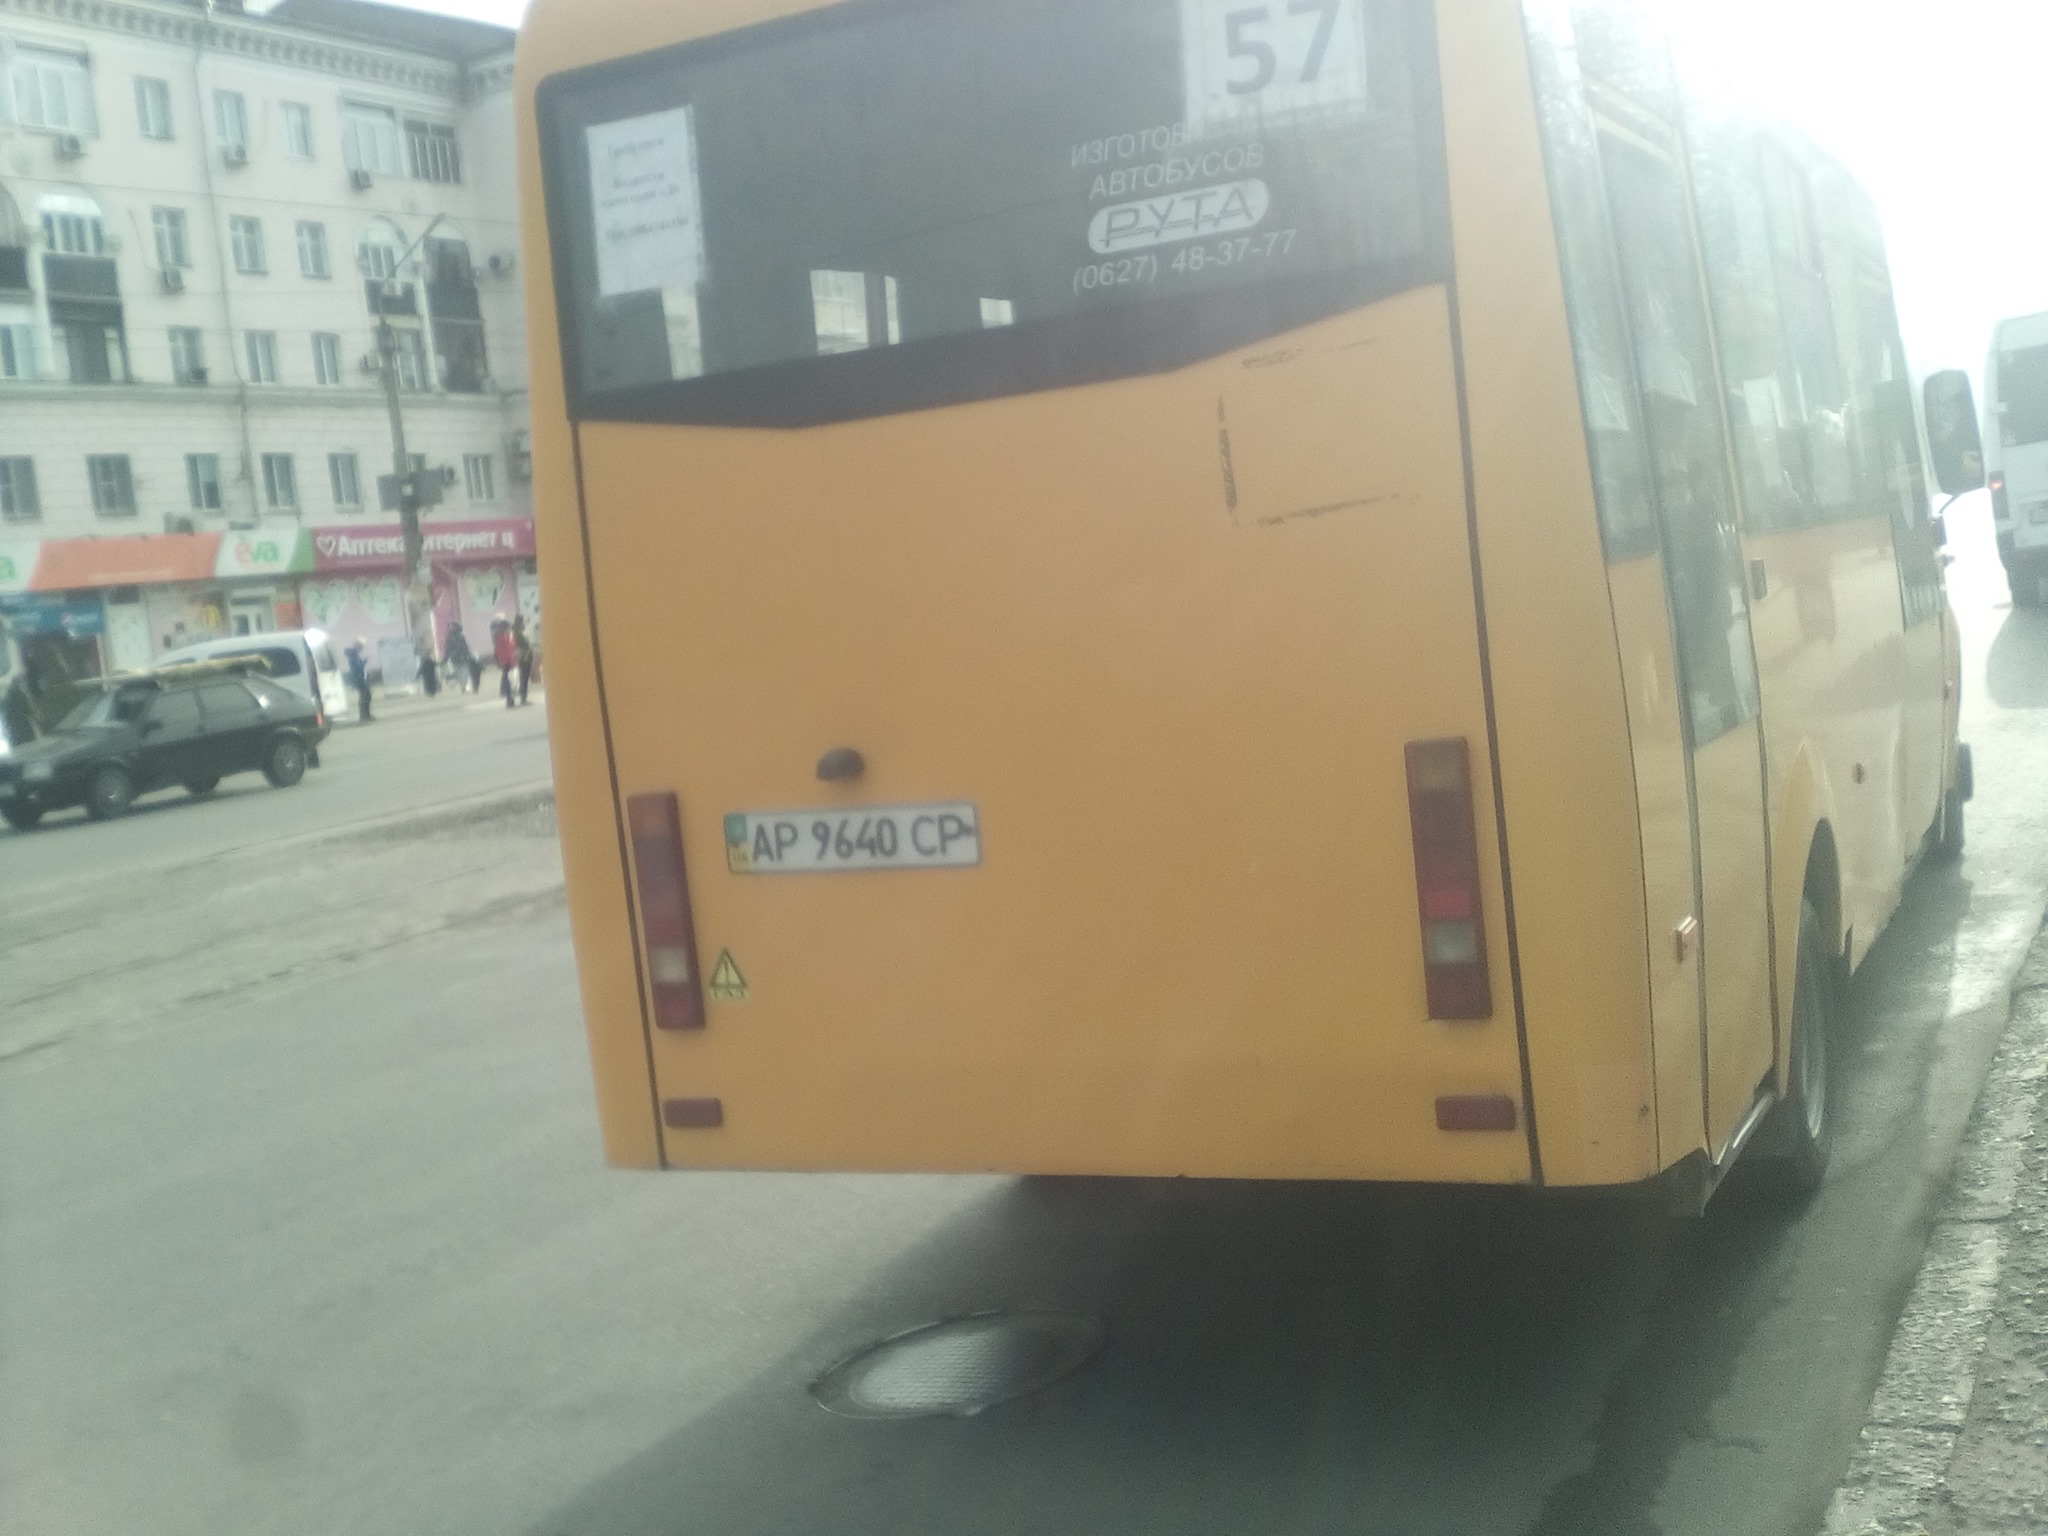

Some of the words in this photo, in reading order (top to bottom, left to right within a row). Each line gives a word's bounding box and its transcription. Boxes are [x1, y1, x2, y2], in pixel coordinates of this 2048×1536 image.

[1224, 0, 1341, 95] 57
[1088, 143, 1265, 200] АВТОБУСОВ
[1099, 186, 1256, 248] РУТА
[1072, 254, 1158, 296] (0627)
[1171, 227, 1298, 273] 48-37-77
[752, 822, 798, 863] AP
[811, 817, 899, 861] 9640
[910, 813, 963, 857] CP
